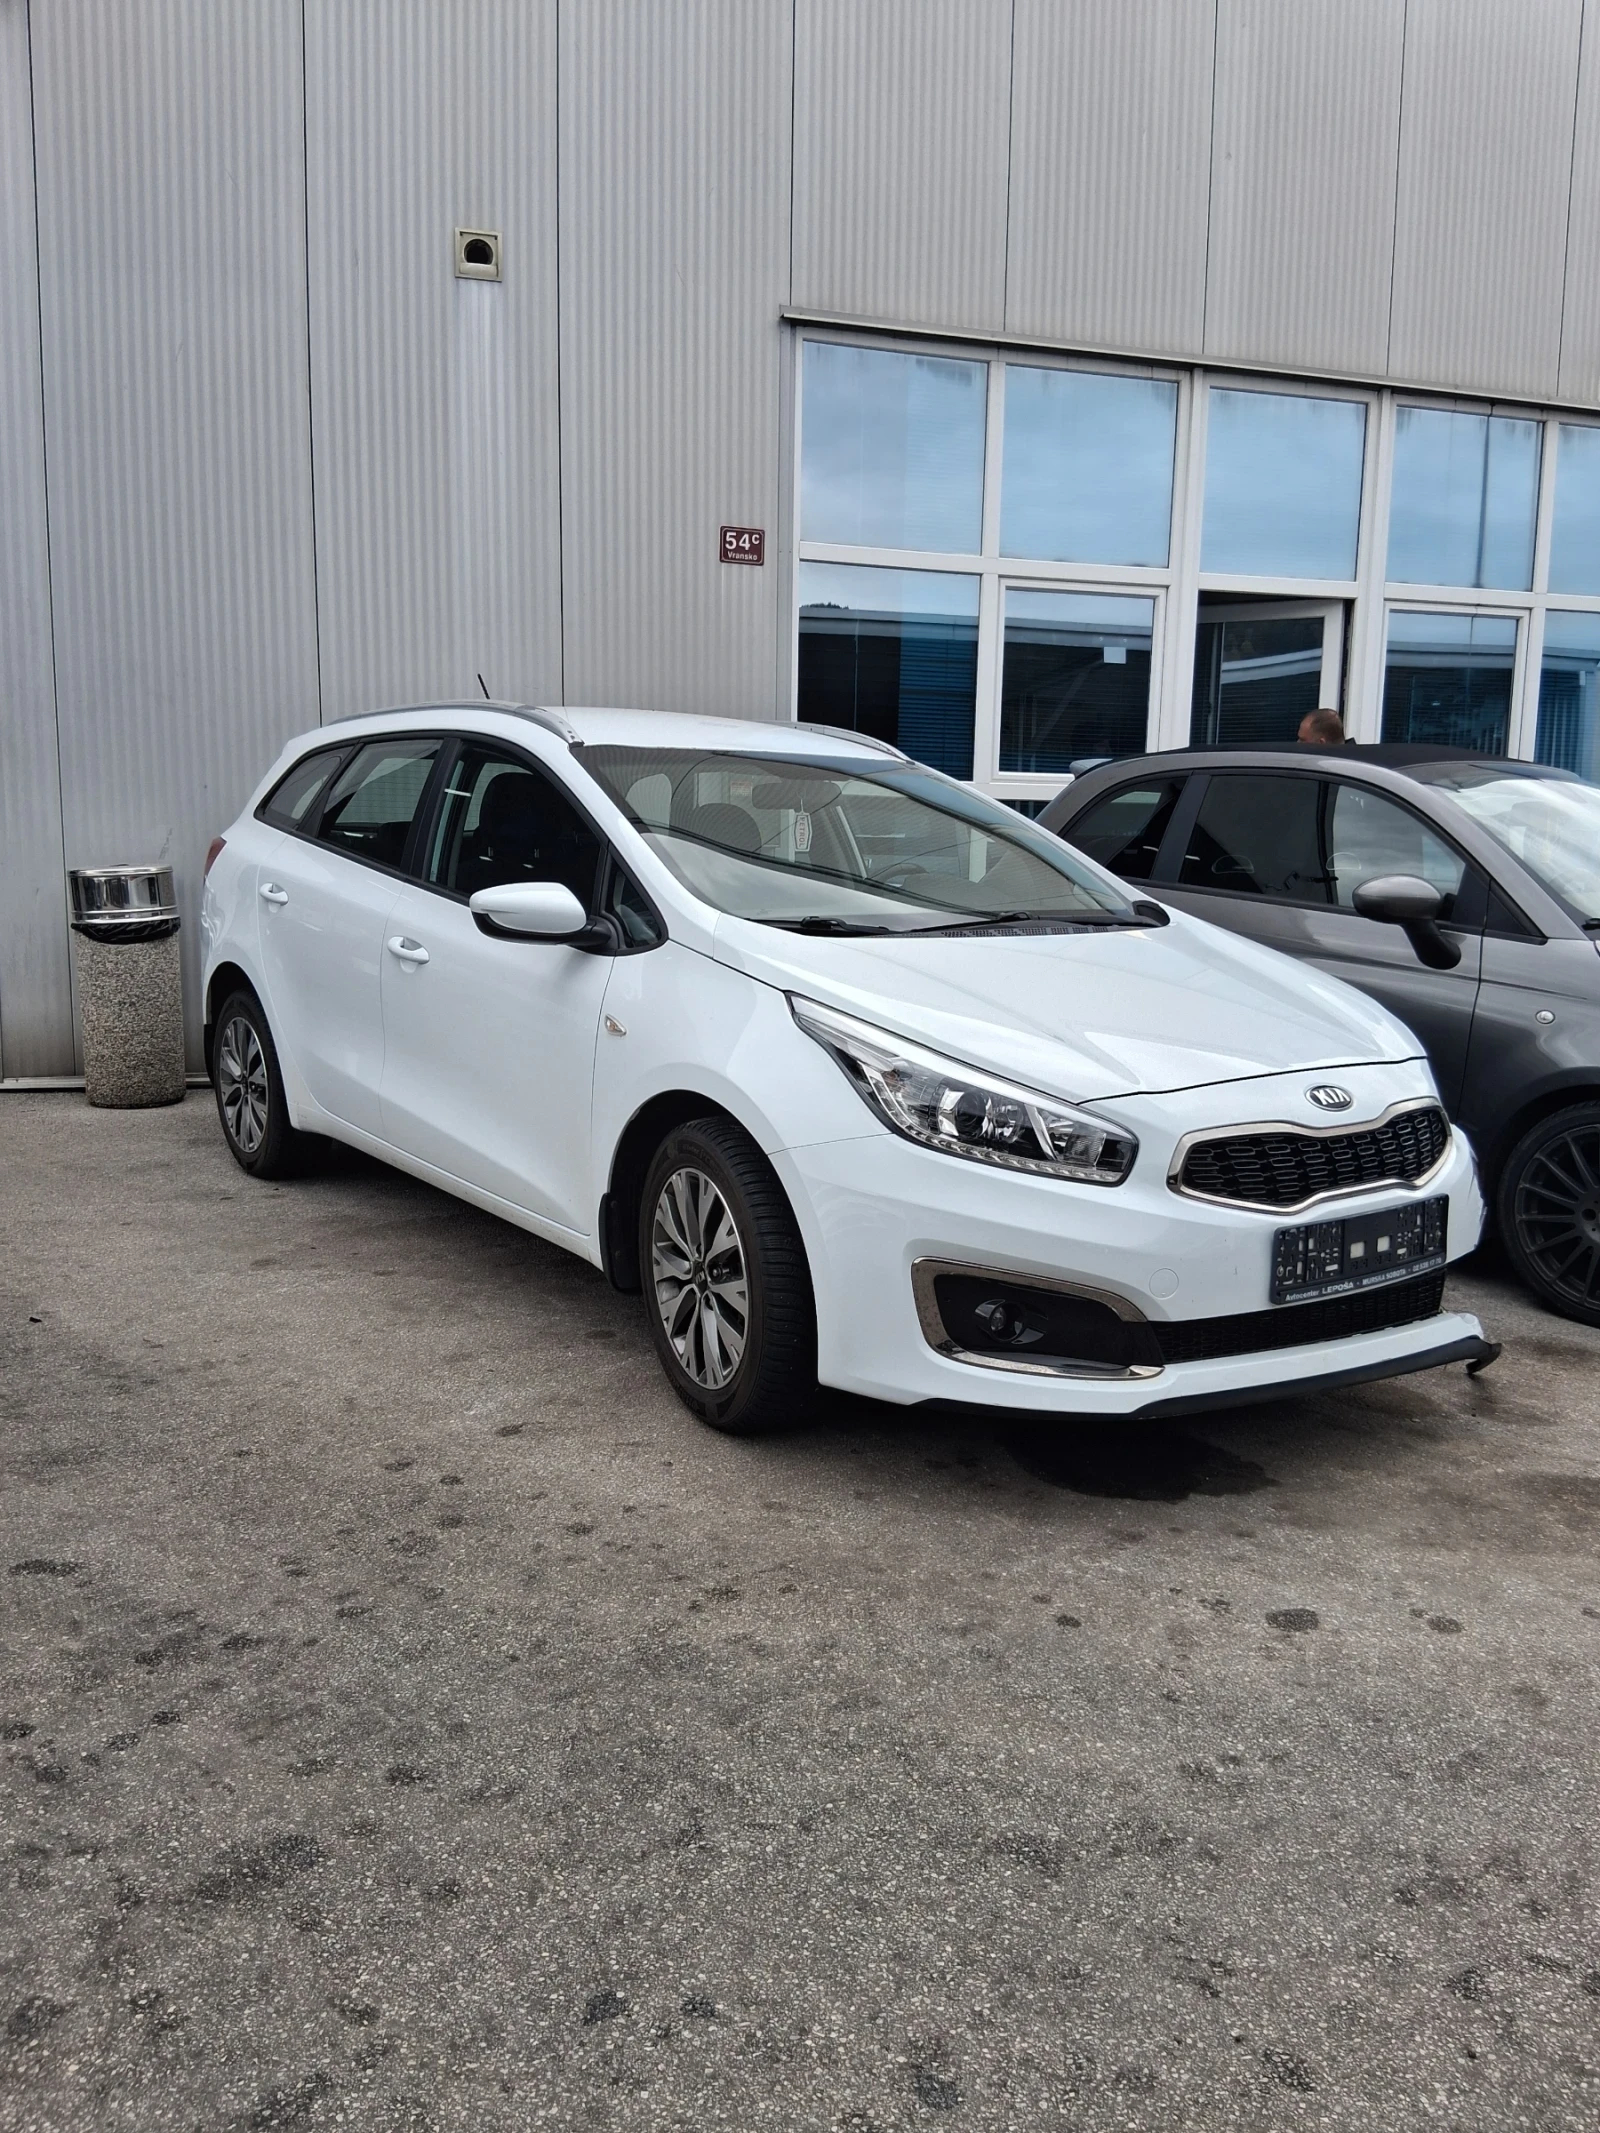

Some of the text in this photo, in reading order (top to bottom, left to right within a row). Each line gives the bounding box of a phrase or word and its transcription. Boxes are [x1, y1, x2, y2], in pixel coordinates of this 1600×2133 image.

[727, 550, 758, 561] Vransko
[1312, 1087, 1351, 1105] KIA
[1285, 1289, 1320, 1302] Avtocenter
